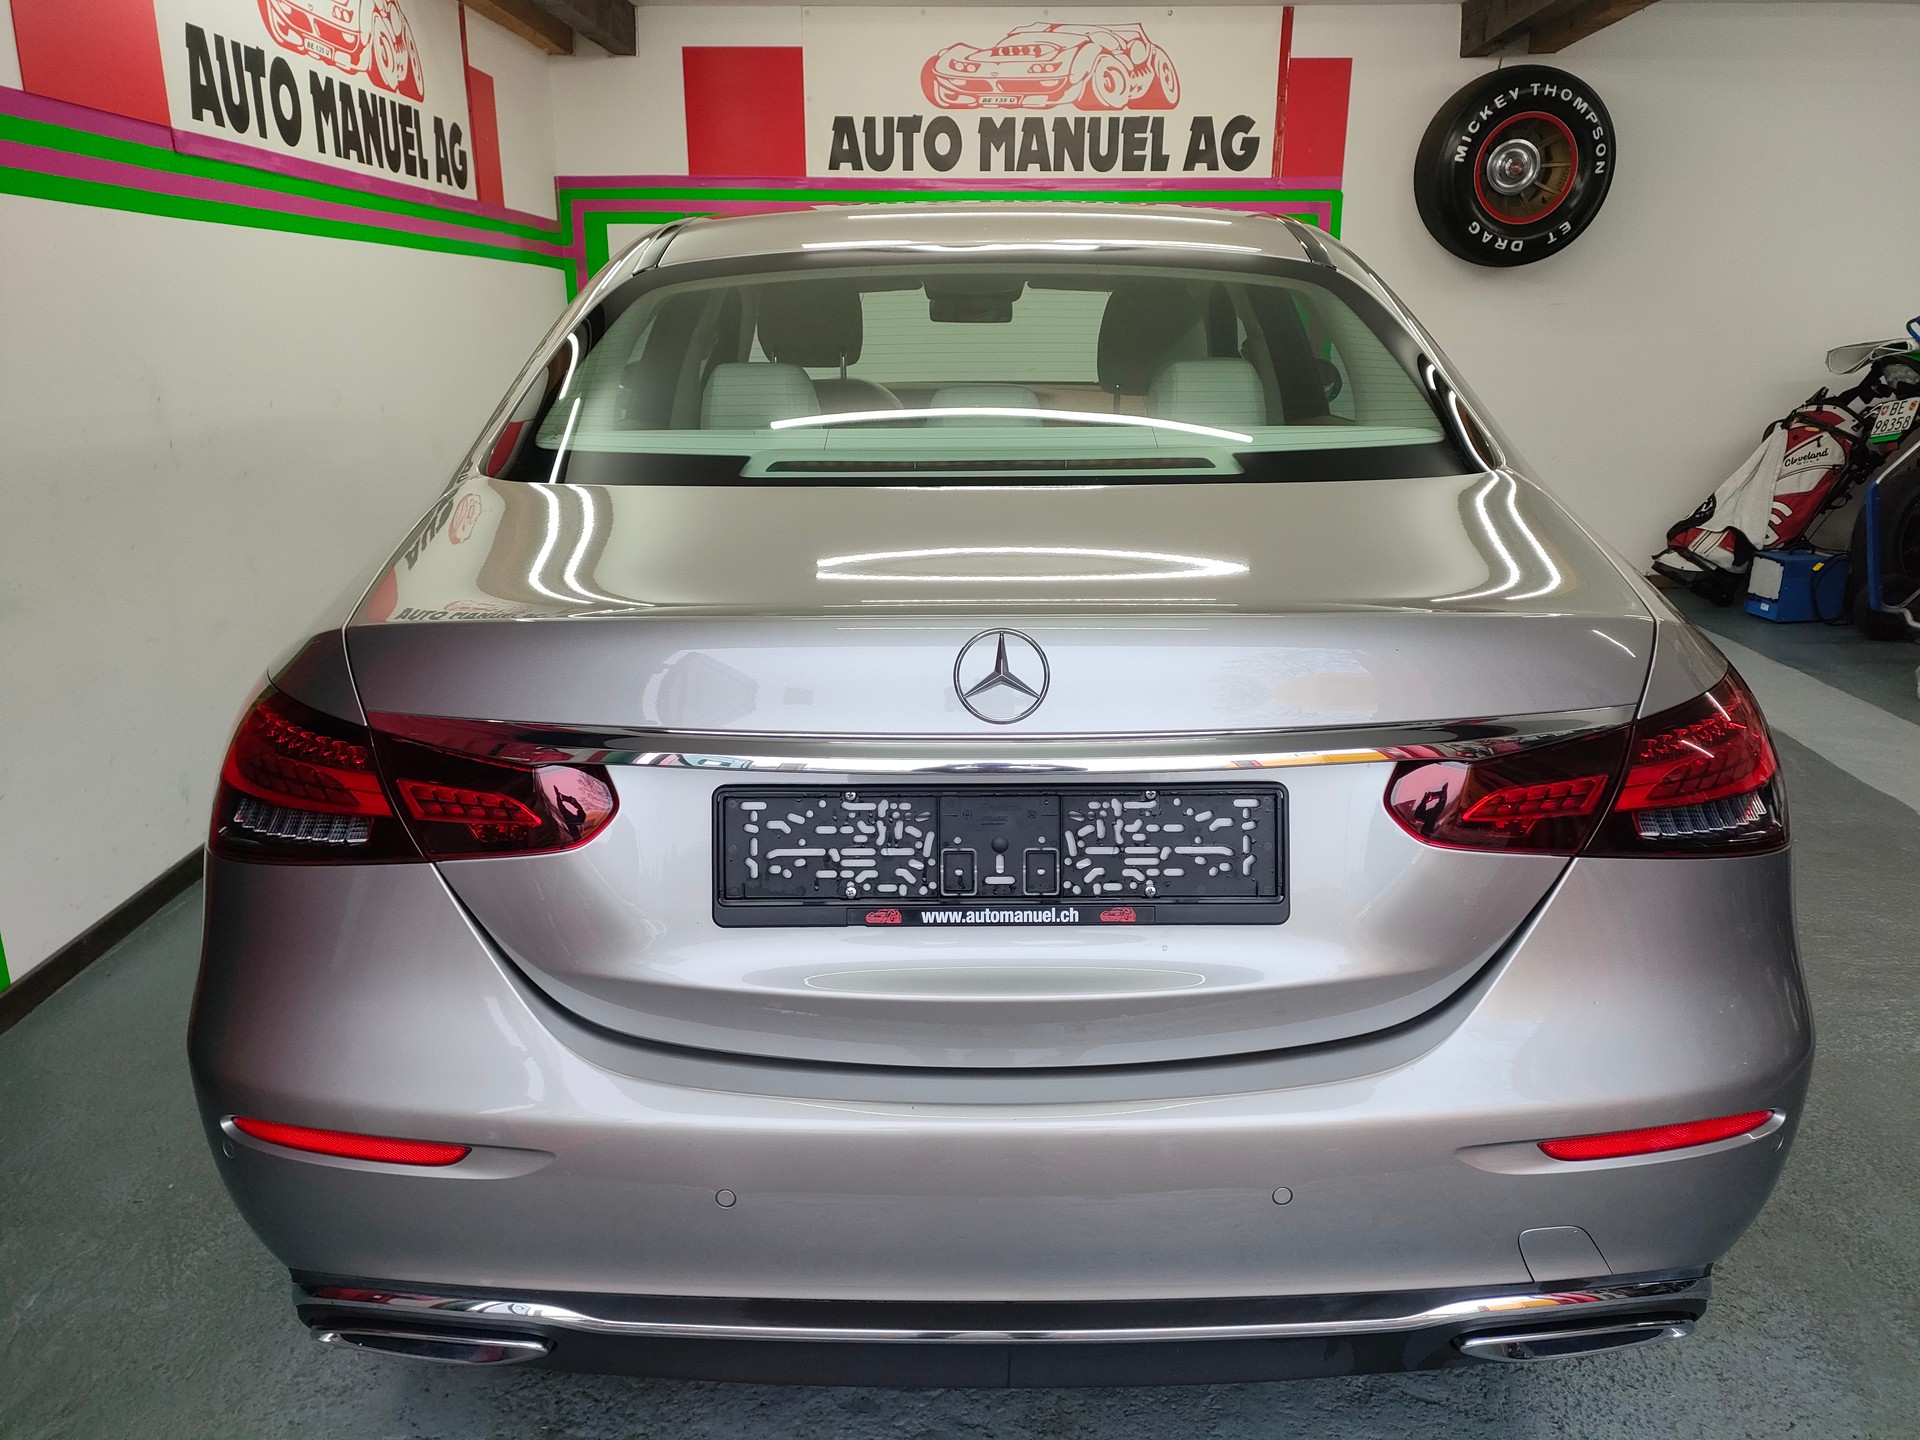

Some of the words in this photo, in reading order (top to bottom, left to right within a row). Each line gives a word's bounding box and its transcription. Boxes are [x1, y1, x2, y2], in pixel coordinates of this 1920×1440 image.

[185, 22, 302, 147] AUTO
[309, 70, 429, 180] MANUEL
[433, 116, 468, 190] AG
[1454, 87, 1519, 163] MICKEY
[1530, 82, 1607, 174] THOMPSON
[828, 114, 962, 172] AUTO
[977, 115, 1170, 172] MANUEL
[1182, 114, 1260, 172] AG
[1467, 221, 1524, 252] DRAG
[1547, 221, 1572, 244] ET
[1889, 400, 1908, 416] BE
[1874, 416, 1911, 434] 98358
[1784, 447, 1829, 467] Cleveland
[921, 907, 1079, 923] www.automanuel.ch
